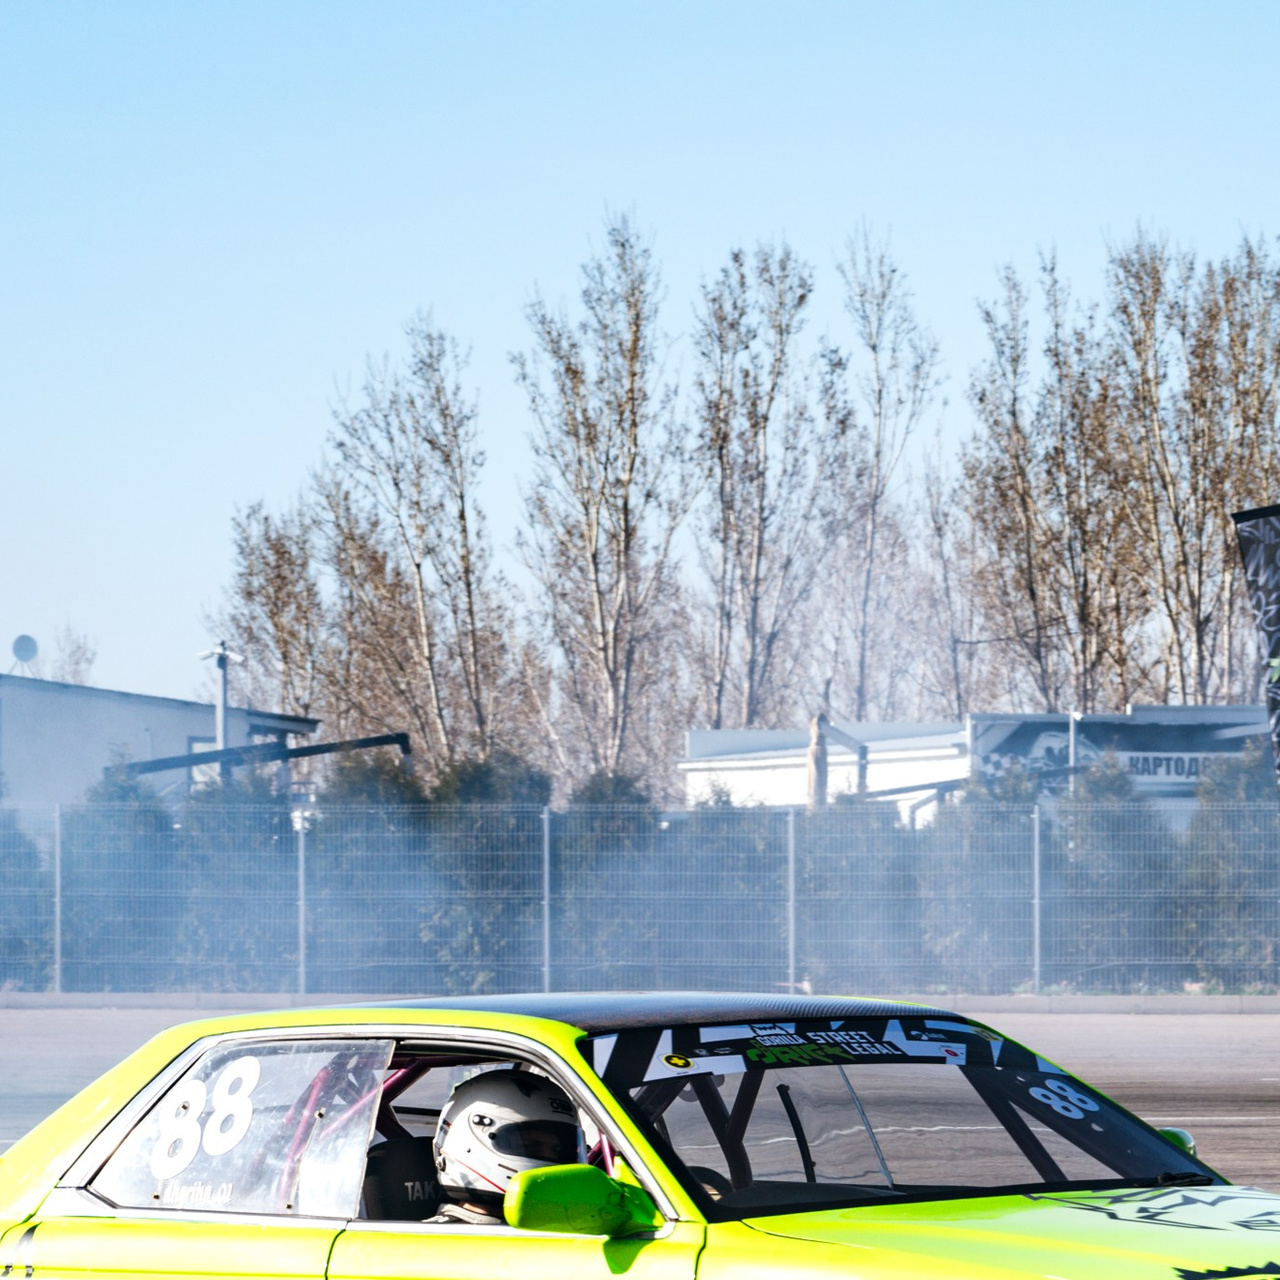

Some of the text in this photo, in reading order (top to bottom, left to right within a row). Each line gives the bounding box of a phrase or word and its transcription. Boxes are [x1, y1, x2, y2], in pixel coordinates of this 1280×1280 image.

[1128, 755, 1240, 779] КАРТОДР
[755, 1034, 808, 1046] GORILLA
[806, 1031, 876, 1044] STREET
[839, 1043, 903, 1055] LEGAL
[1028, 1079, 1100, 1120] 88
[149, 1056, 260, 1180] 88
[404, 1181, 441, 1201] TAK
